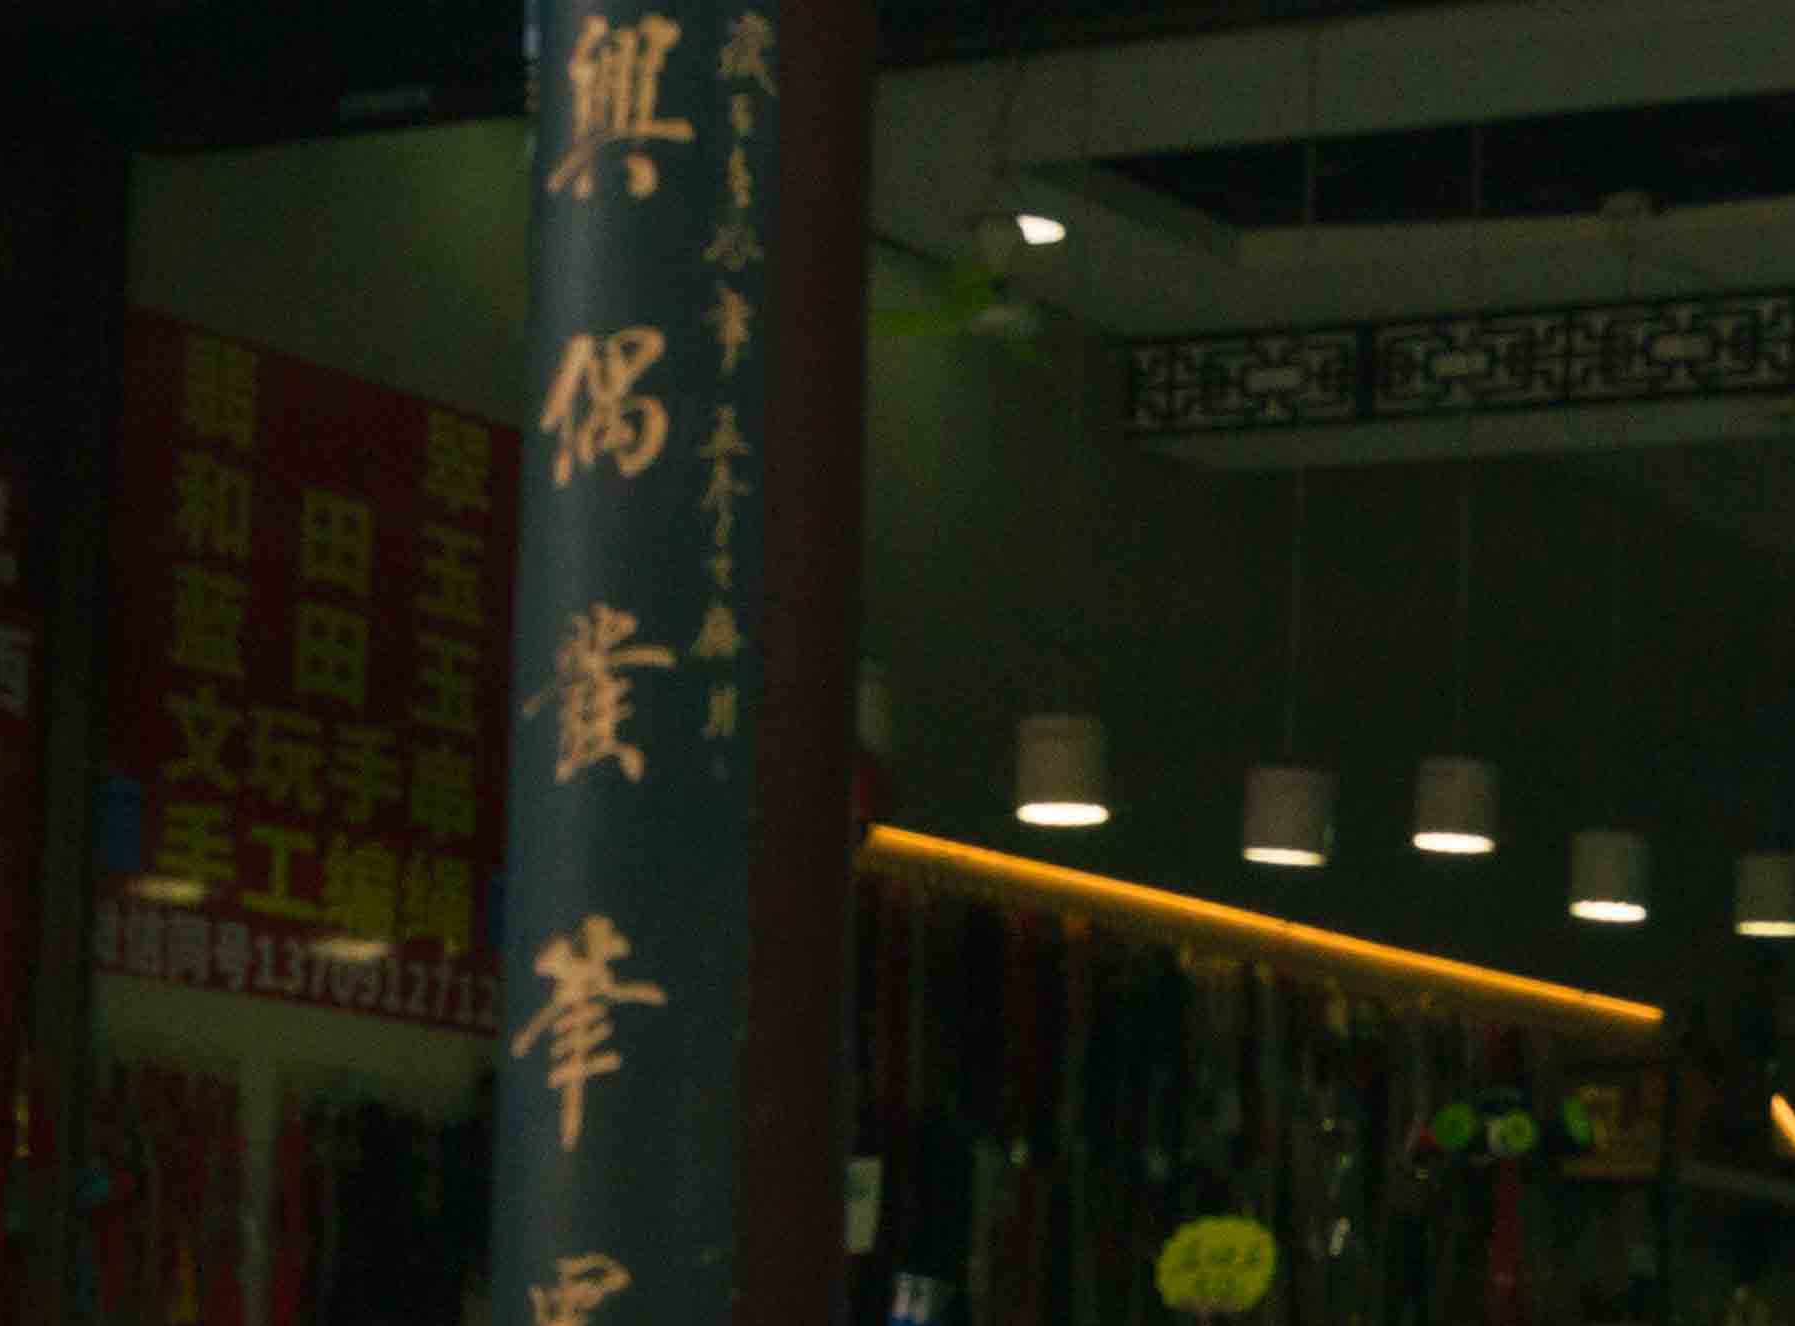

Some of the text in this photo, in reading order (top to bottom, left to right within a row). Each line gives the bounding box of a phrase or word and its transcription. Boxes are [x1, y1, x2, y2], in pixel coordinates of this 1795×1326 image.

[183, 333, 491, 513] 翡翠
[172, 448, 484, 628] 和田玉
[168, 562, 480, 738] 蓝田玉
[161, 685, 478, 838] 文玩手串
[153, 799, 474, 958] 手工编绳
